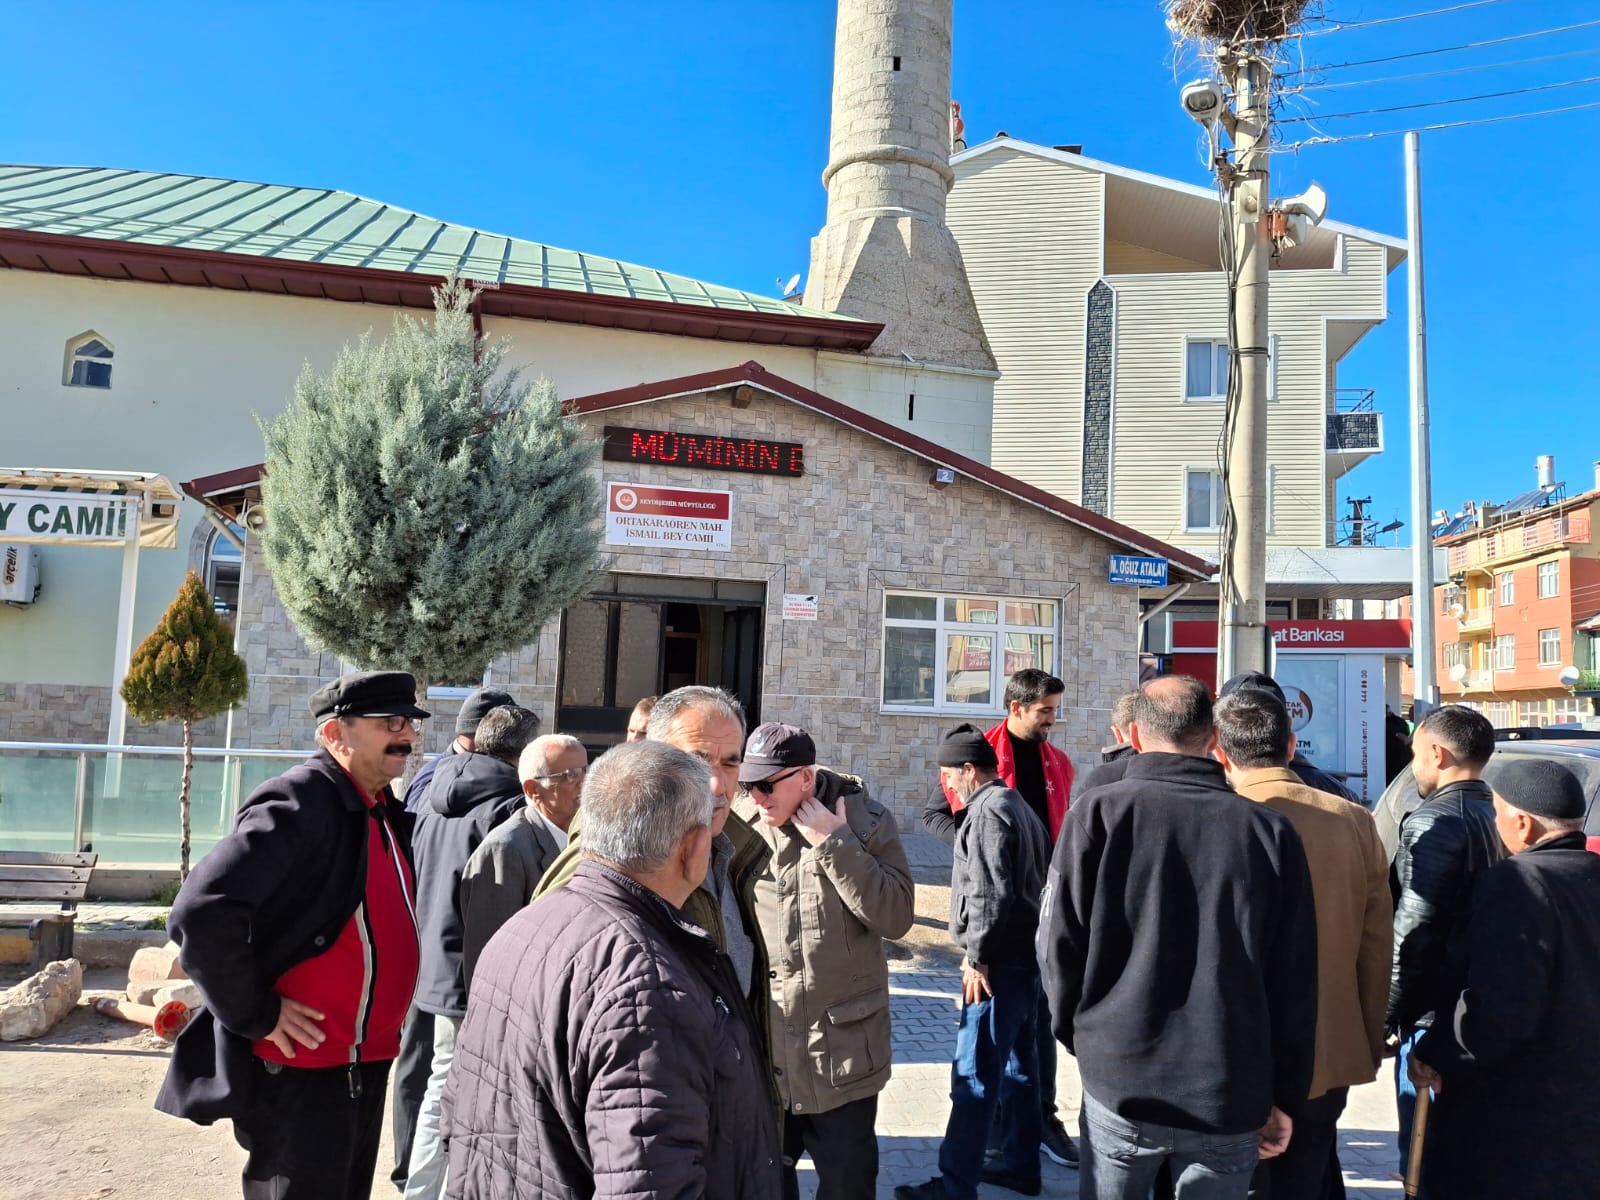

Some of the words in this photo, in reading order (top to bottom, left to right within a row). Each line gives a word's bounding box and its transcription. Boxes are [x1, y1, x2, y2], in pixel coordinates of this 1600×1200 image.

[28, 500, 127, 537] CAMİİ
[663, 531, 684, 541] BEY
[6, 546, 18, 583] arçelik
[1120, 557, 1139, 576] OĞUZ
[1139, 560, 1166, 578] ATALAY
[1290, 627, 1345, 642] Bankası
